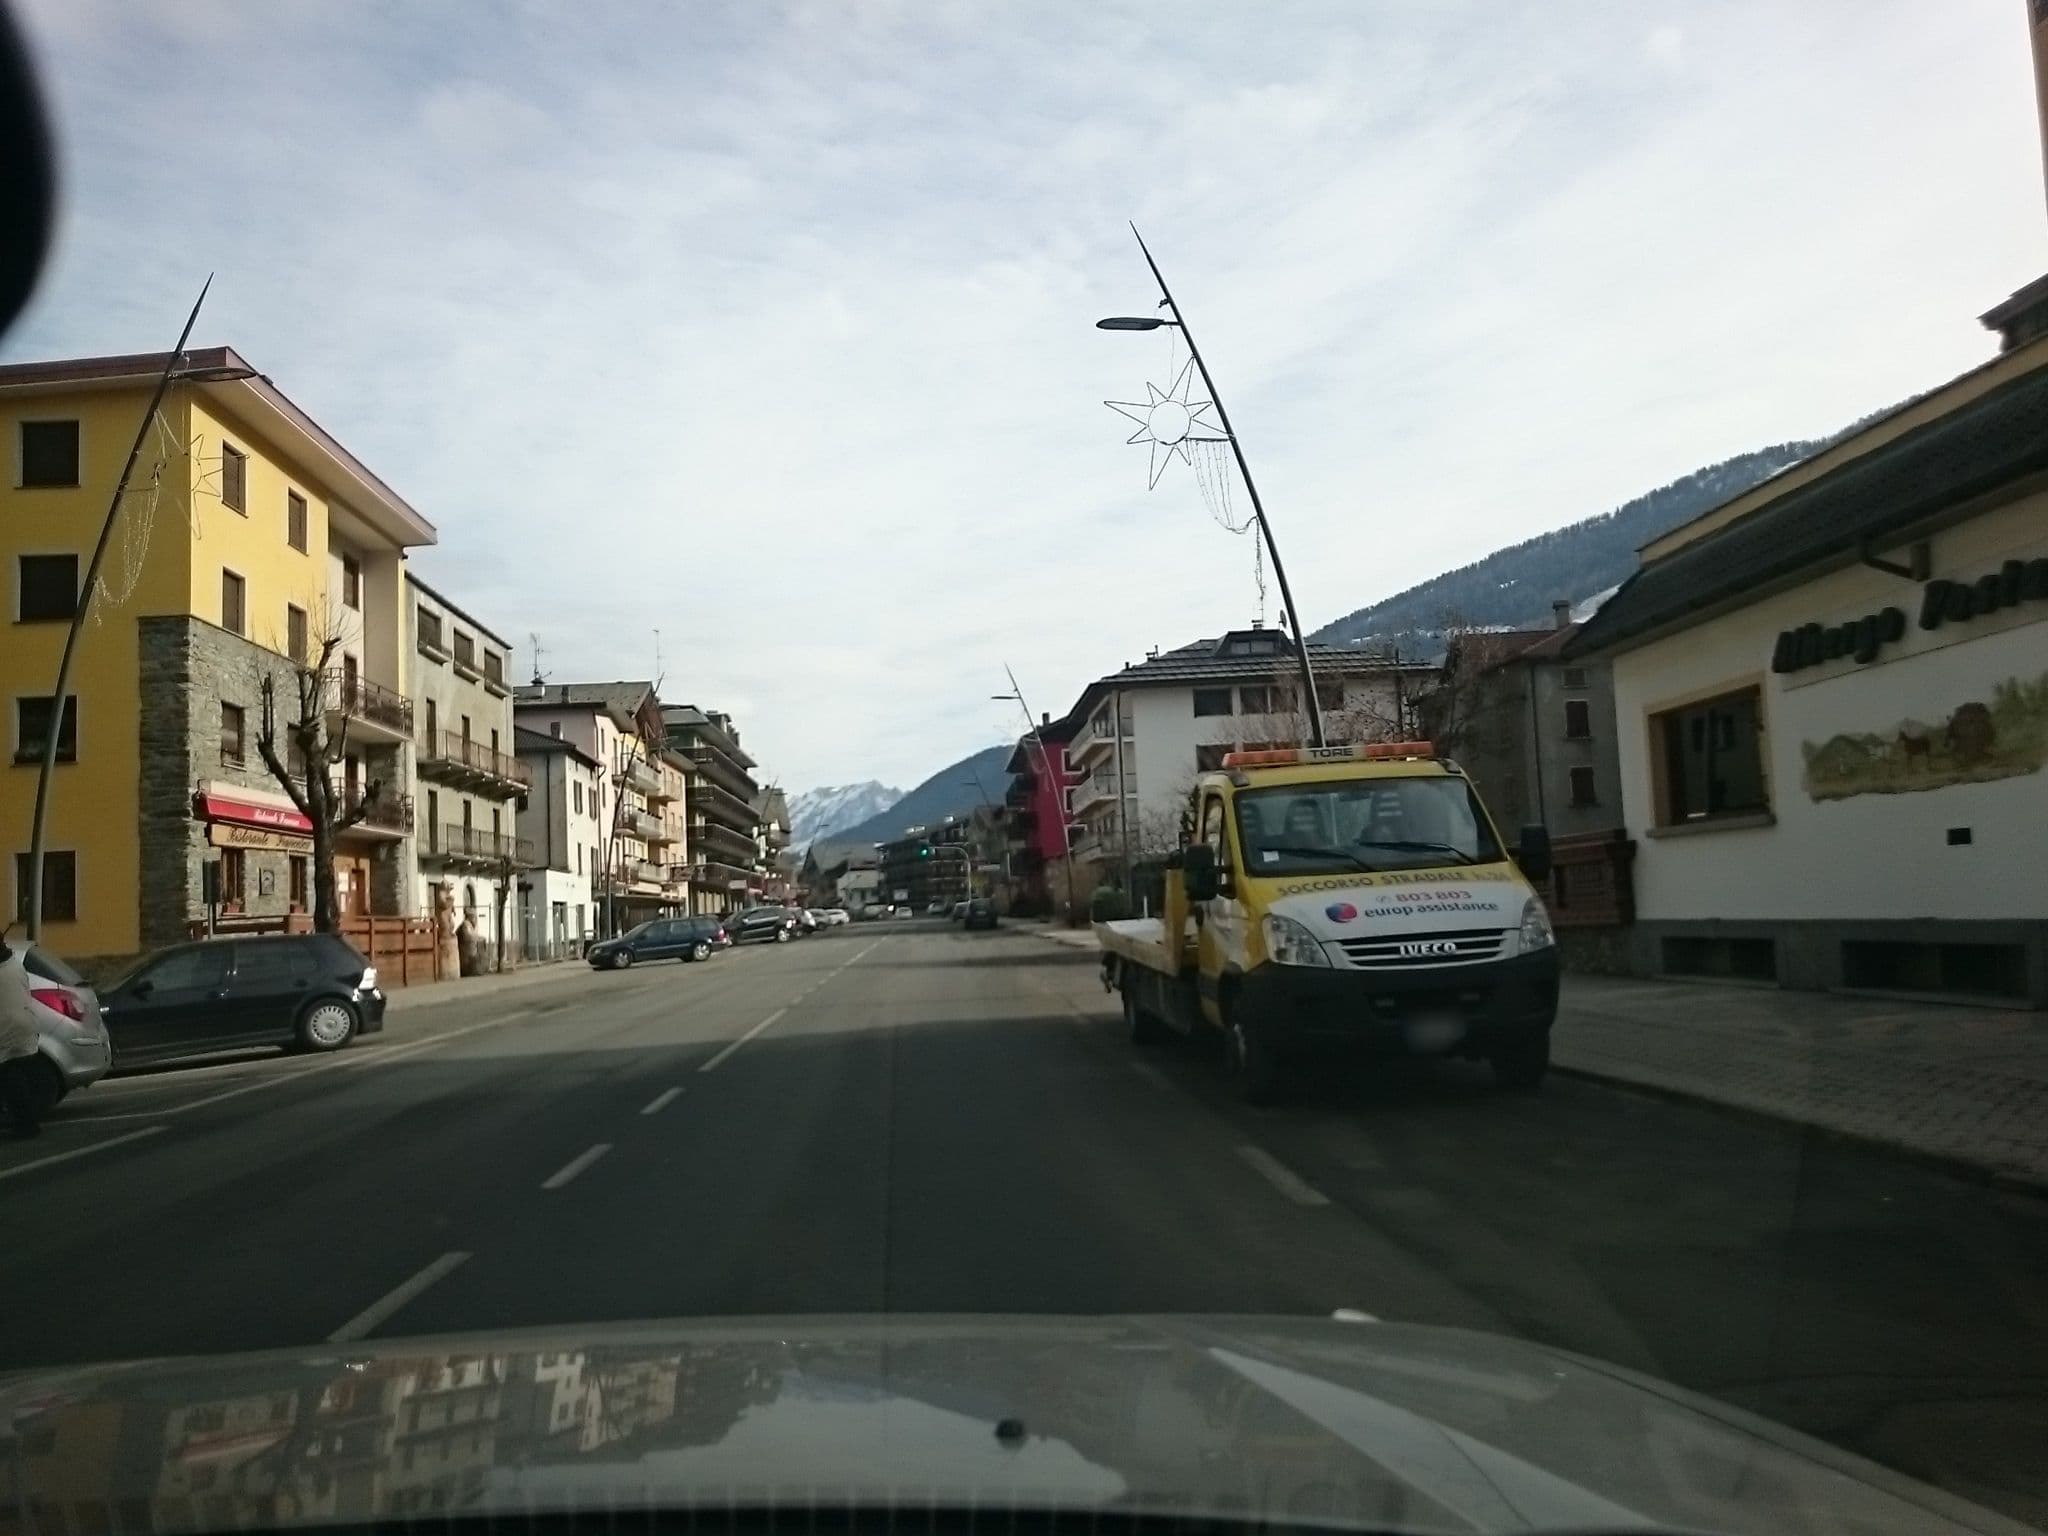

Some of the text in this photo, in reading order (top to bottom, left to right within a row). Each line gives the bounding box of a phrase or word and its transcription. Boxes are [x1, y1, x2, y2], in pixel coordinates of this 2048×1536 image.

[1310, 747, 1354, 759] TORE
[1278, 876, 1374, 897] SOCCORSO
[1381, 871, 1463, 885] STRADALE
[1396, 889, 1474, 902] 803 803
[1364, 901, 1499, 919] europ assistance
[1400, 942, 1457, 956] IVECO
